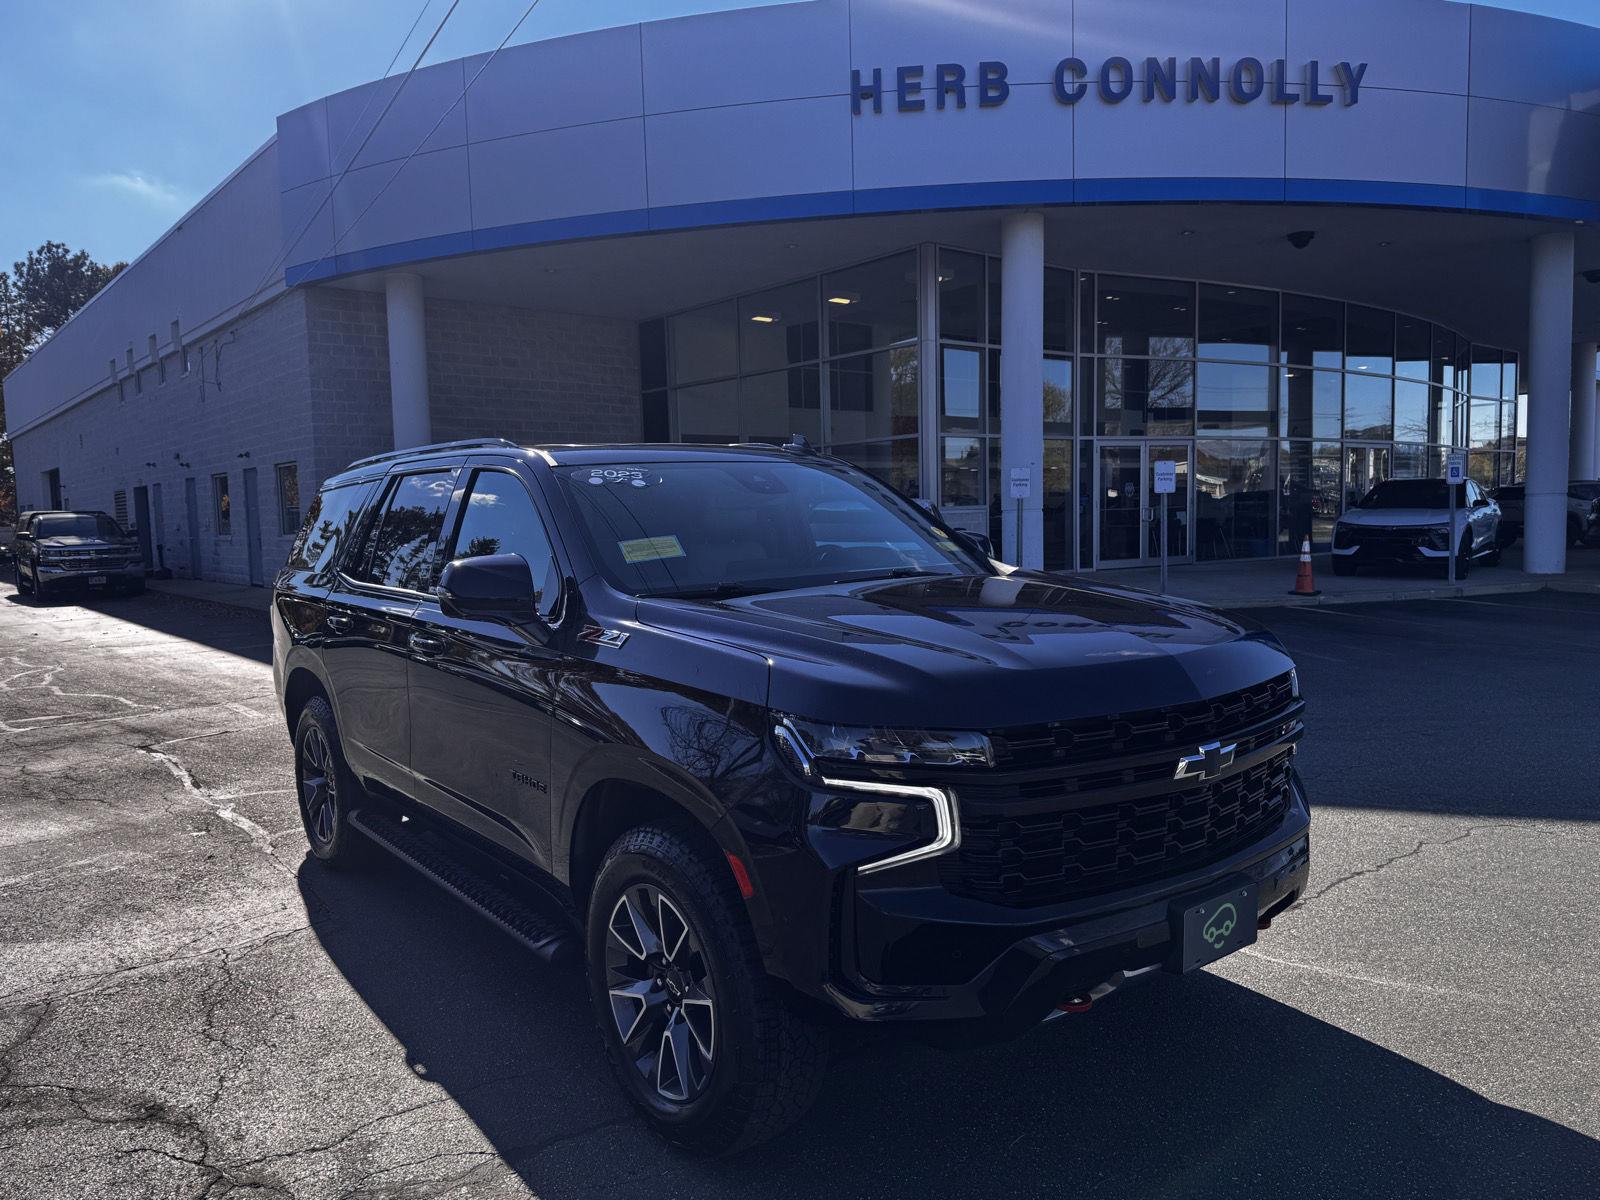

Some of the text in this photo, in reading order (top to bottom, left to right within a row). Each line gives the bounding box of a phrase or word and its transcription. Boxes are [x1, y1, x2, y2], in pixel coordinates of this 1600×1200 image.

[851, 56, 1367, 115] HERB CONNOLLY
[591, 469, 643, 479] 2023
[577, 624, 630, 649] Z71
